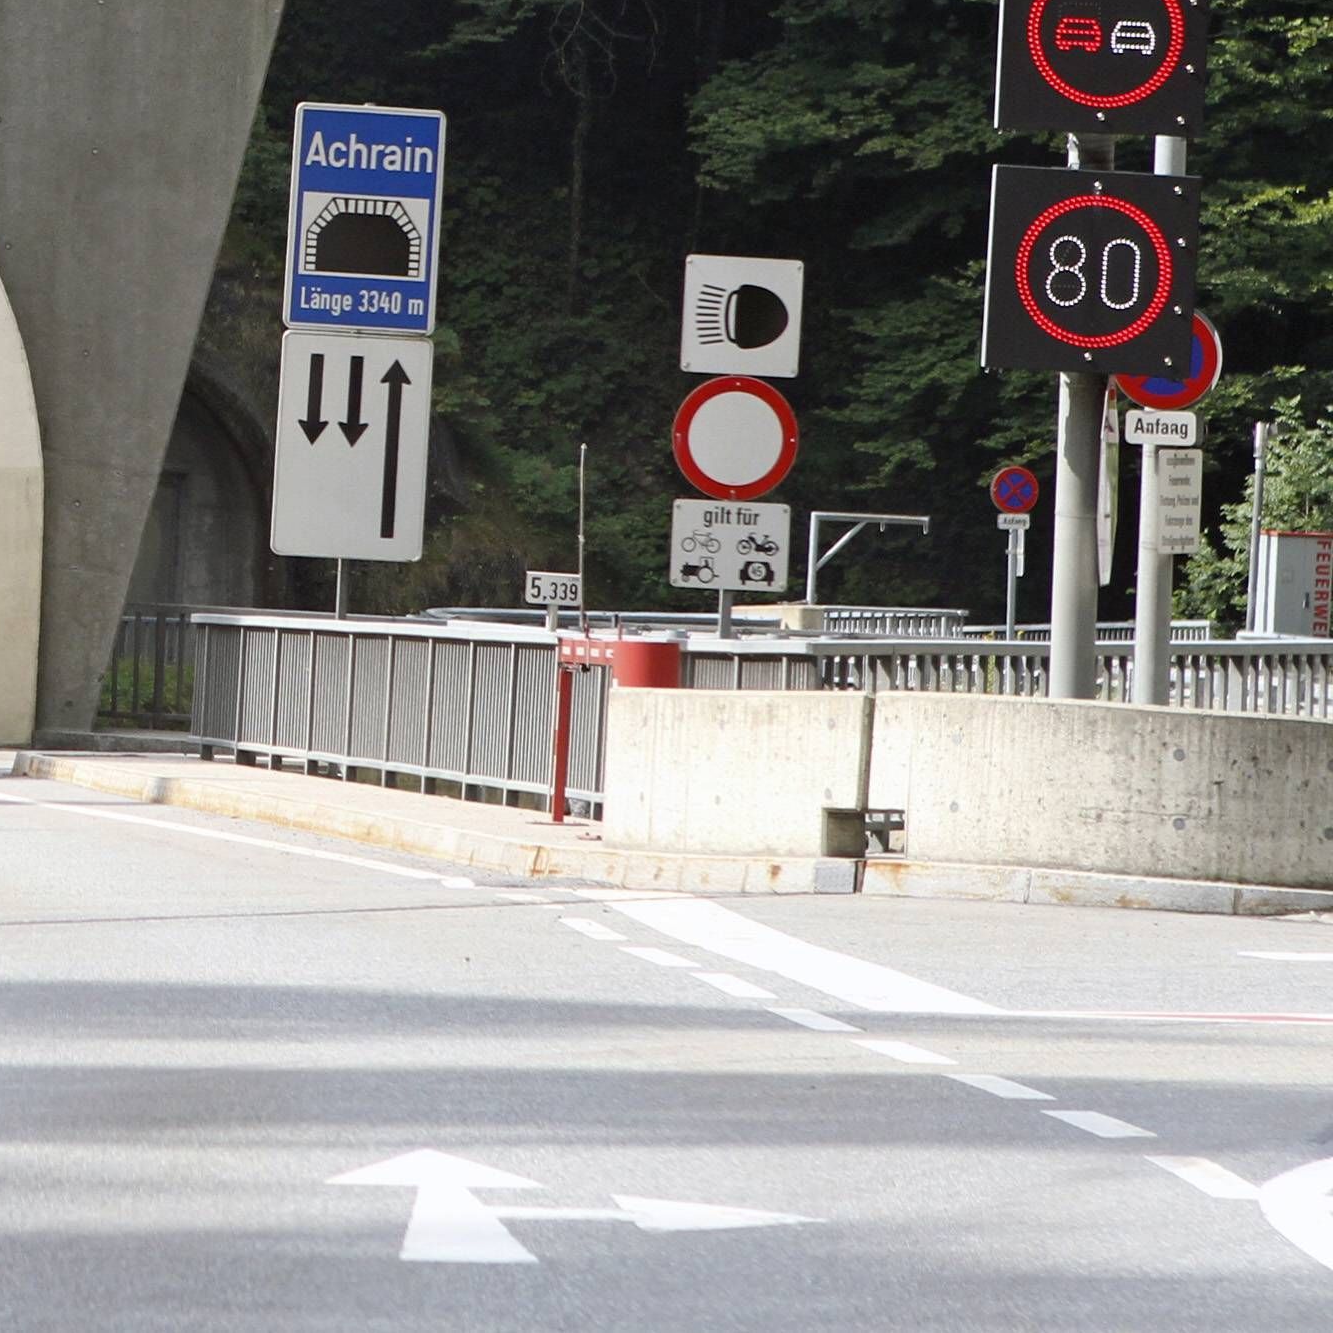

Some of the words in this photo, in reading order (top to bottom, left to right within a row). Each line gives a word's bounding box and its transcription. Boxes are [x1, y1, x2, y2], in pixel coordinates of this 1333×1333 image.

[304, 130, 433, 174] Achrain
[1045, 234, 1141, 311] 80
[300, 285, 352, 316] Länge
[357, 289, 402, 315] 3340
[407, 299, 424, 316] m
[1133, 417, 1189, 439] Anfang
[703, 506, 731, 528] gilt
[736, 507, 760, 526] für
[530, 576, 578, 601] 5,339
